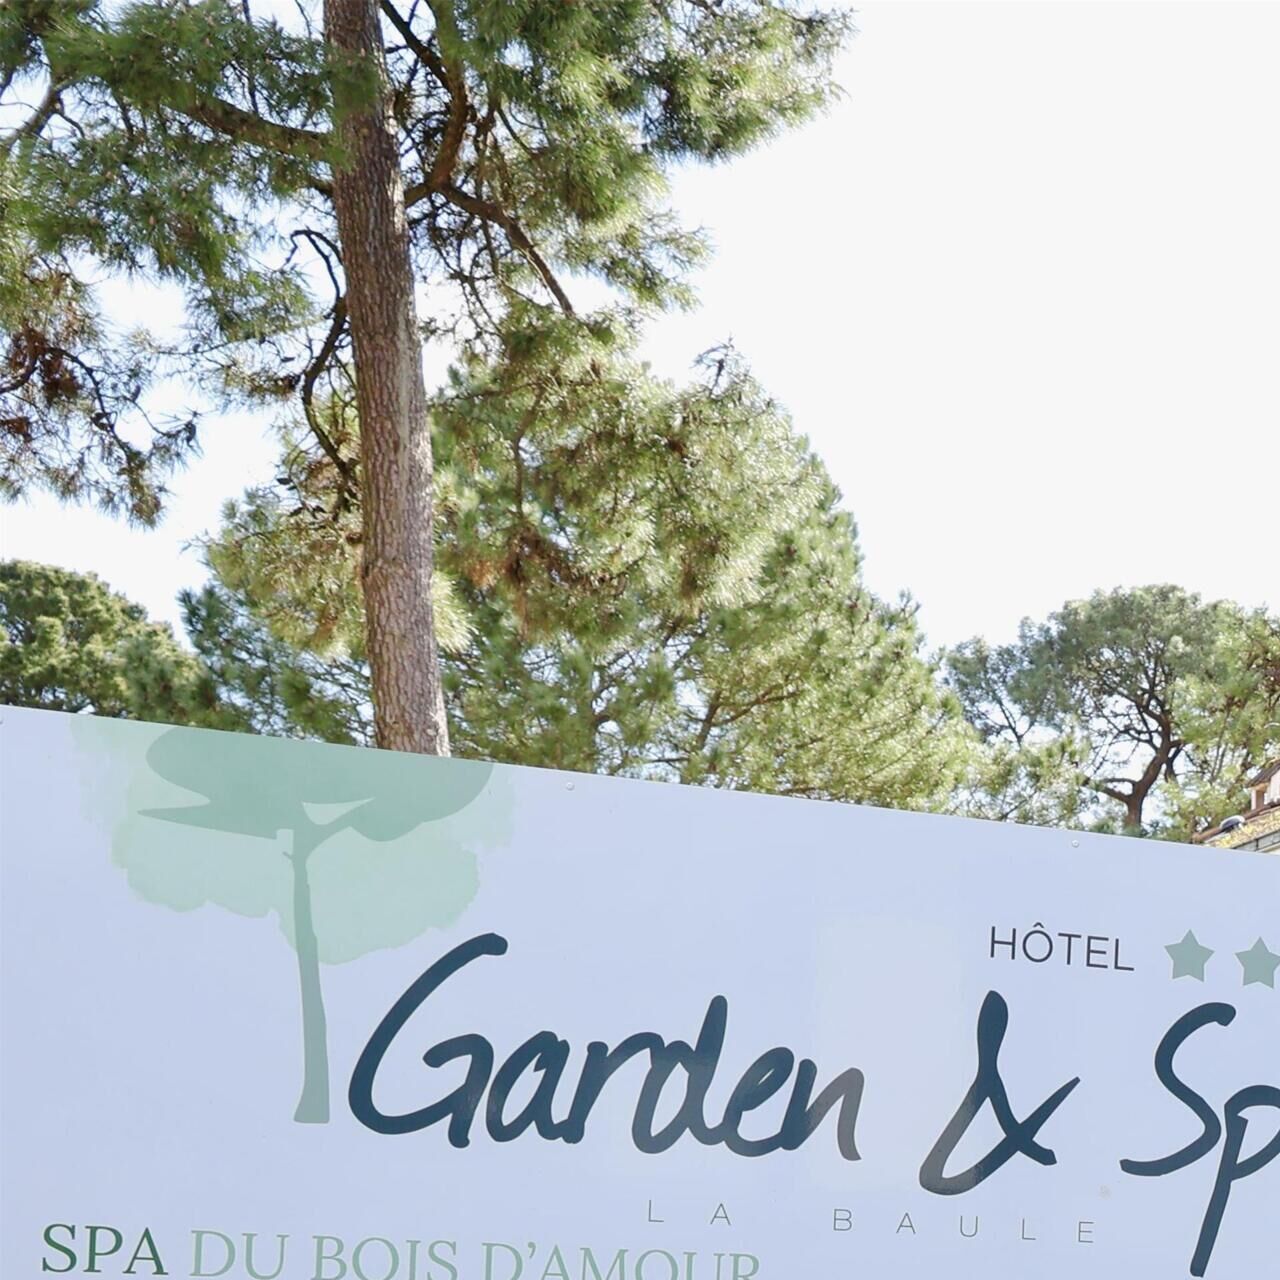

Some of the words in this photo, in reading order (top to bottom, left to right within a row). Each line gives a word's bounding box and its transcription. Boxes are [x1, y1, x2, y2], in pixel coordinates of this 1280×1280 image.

[989, 921, 1135, 972] HÔTEL
[348, 932, 865, 1161] Garden
[919, 990, 1081, 1196] &
[647, 1199, 732, 1226] LA
[832, 1208, 1095, 1243] BAULE
[41, 1223, 169, 1276] SPA
[189, 1229, 291, 1280] DU
